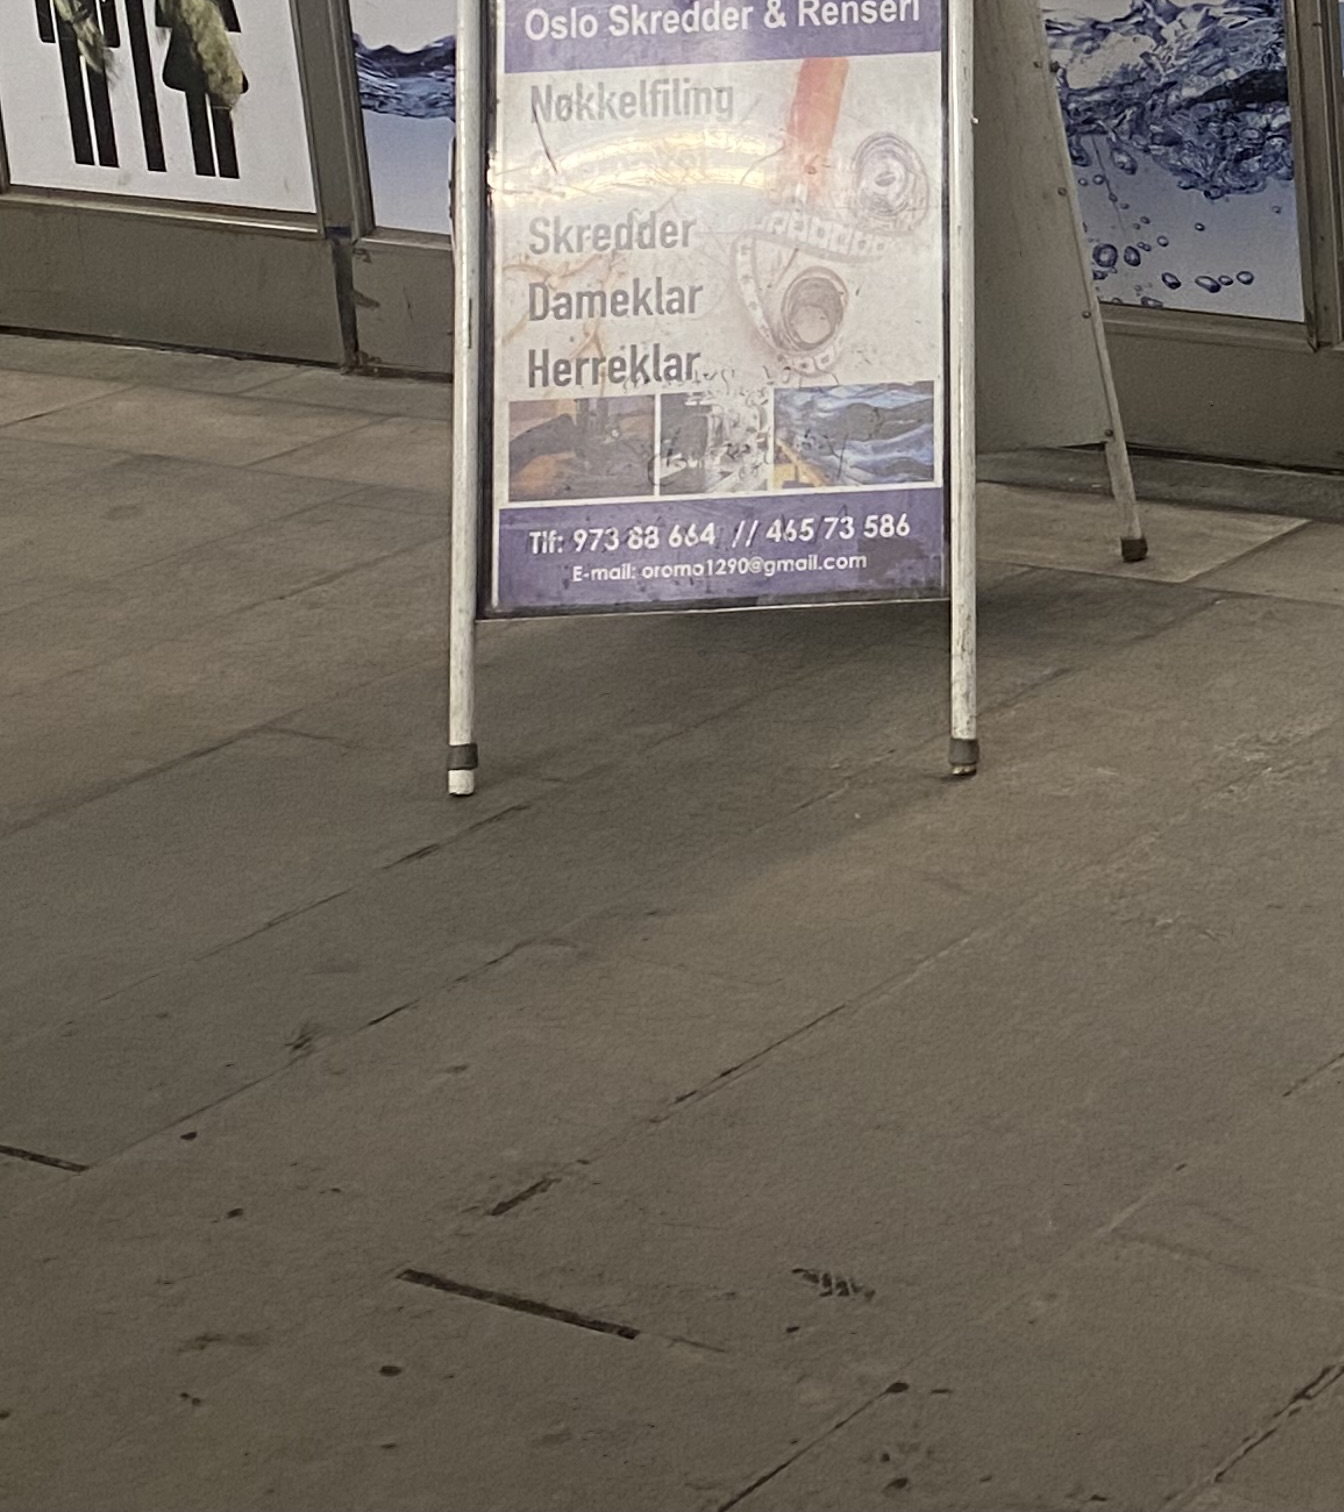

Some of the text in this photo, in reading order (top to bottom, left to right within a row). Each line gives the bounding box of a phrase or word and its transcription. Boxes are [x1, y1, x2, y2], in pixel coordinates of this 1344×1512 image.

[525, 6, 598, 41] Oslo
[530, 77, 733, 124] Nøkkelfiling
[528, 211, 697, 255] Skredder
[528, 276, 703, 321] Dameklar
[528, 342, 701, 388] Herreklar
[529, 529, 564, 554] Tlf:
[573, 528, 618, 552] 973
[627, 525, 660, 550] 88
[668, 522, 715, 548] 664
[766, 516, 814, 543] 465
[824, 515, 854, 540] 73
[864, 512, 910, 538] 586
[572, 552, 867, 582] E-mail: oromo1290@gmail.com
